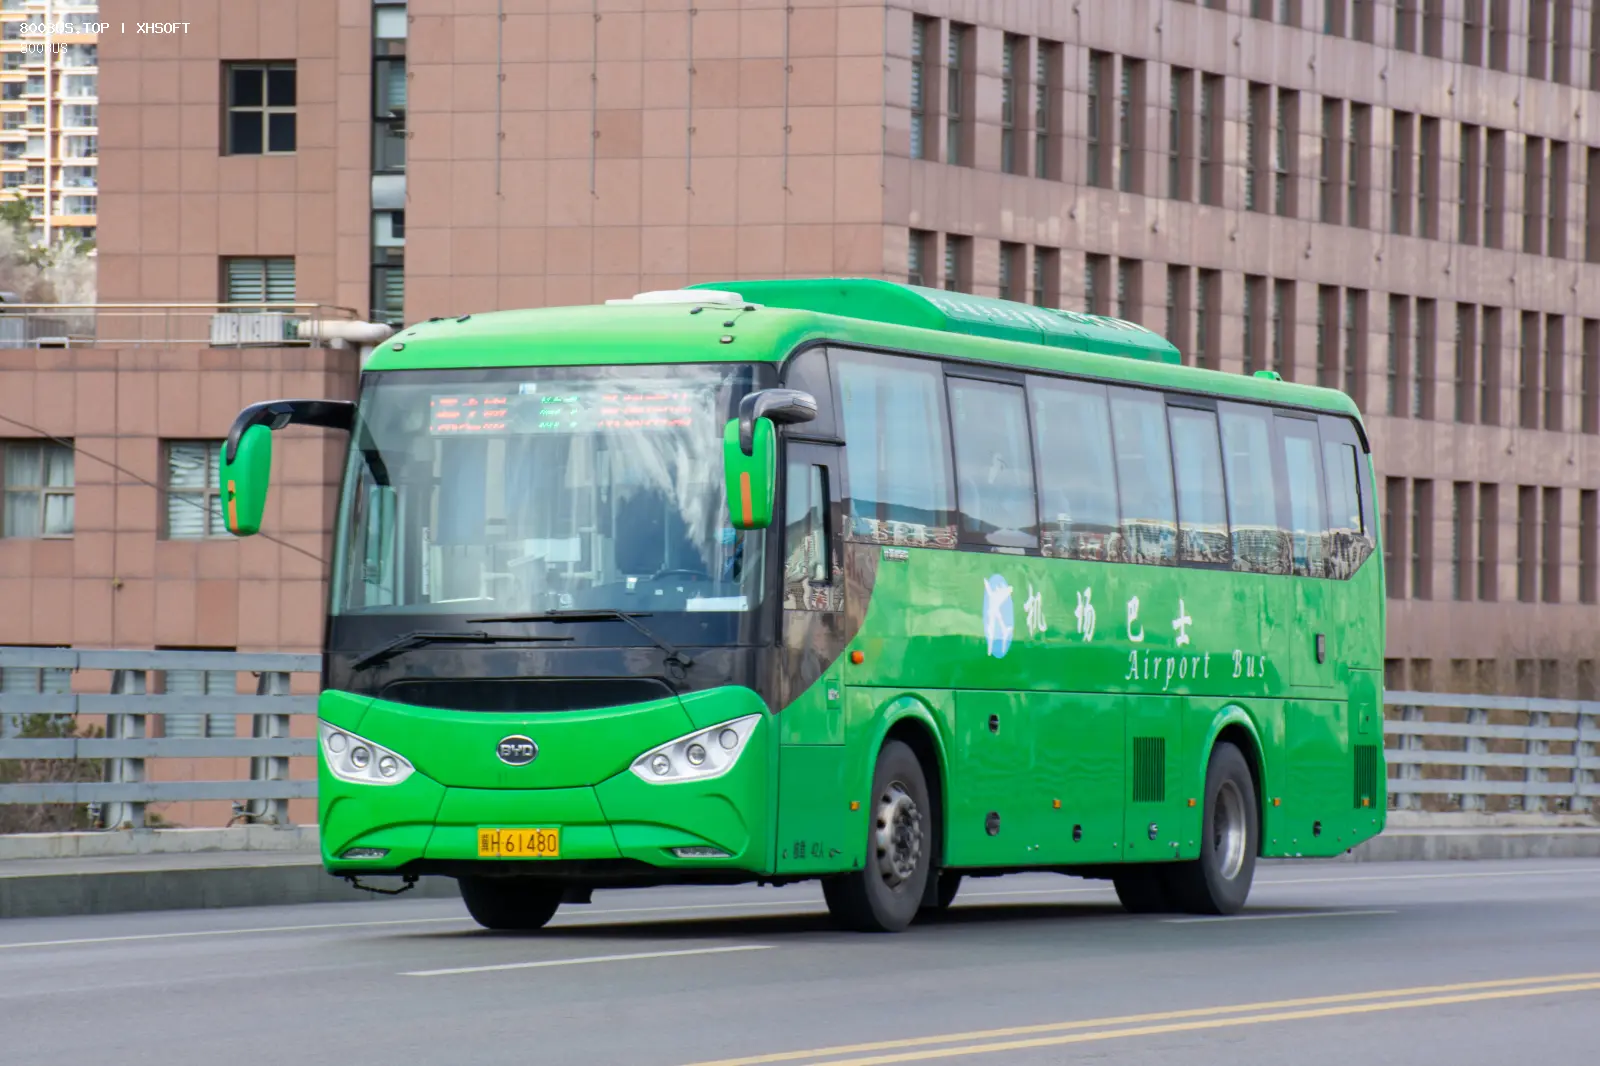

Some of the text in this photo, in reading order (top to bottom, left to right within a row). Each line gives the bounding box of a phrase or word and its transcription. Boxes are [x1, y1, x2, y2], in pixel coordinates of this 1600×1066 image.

[1023, 583, 1194, 647] 机场巴士
[1125, 649, 1267, 692] Airport Bus
[500, 744, 534, 757] BYD
